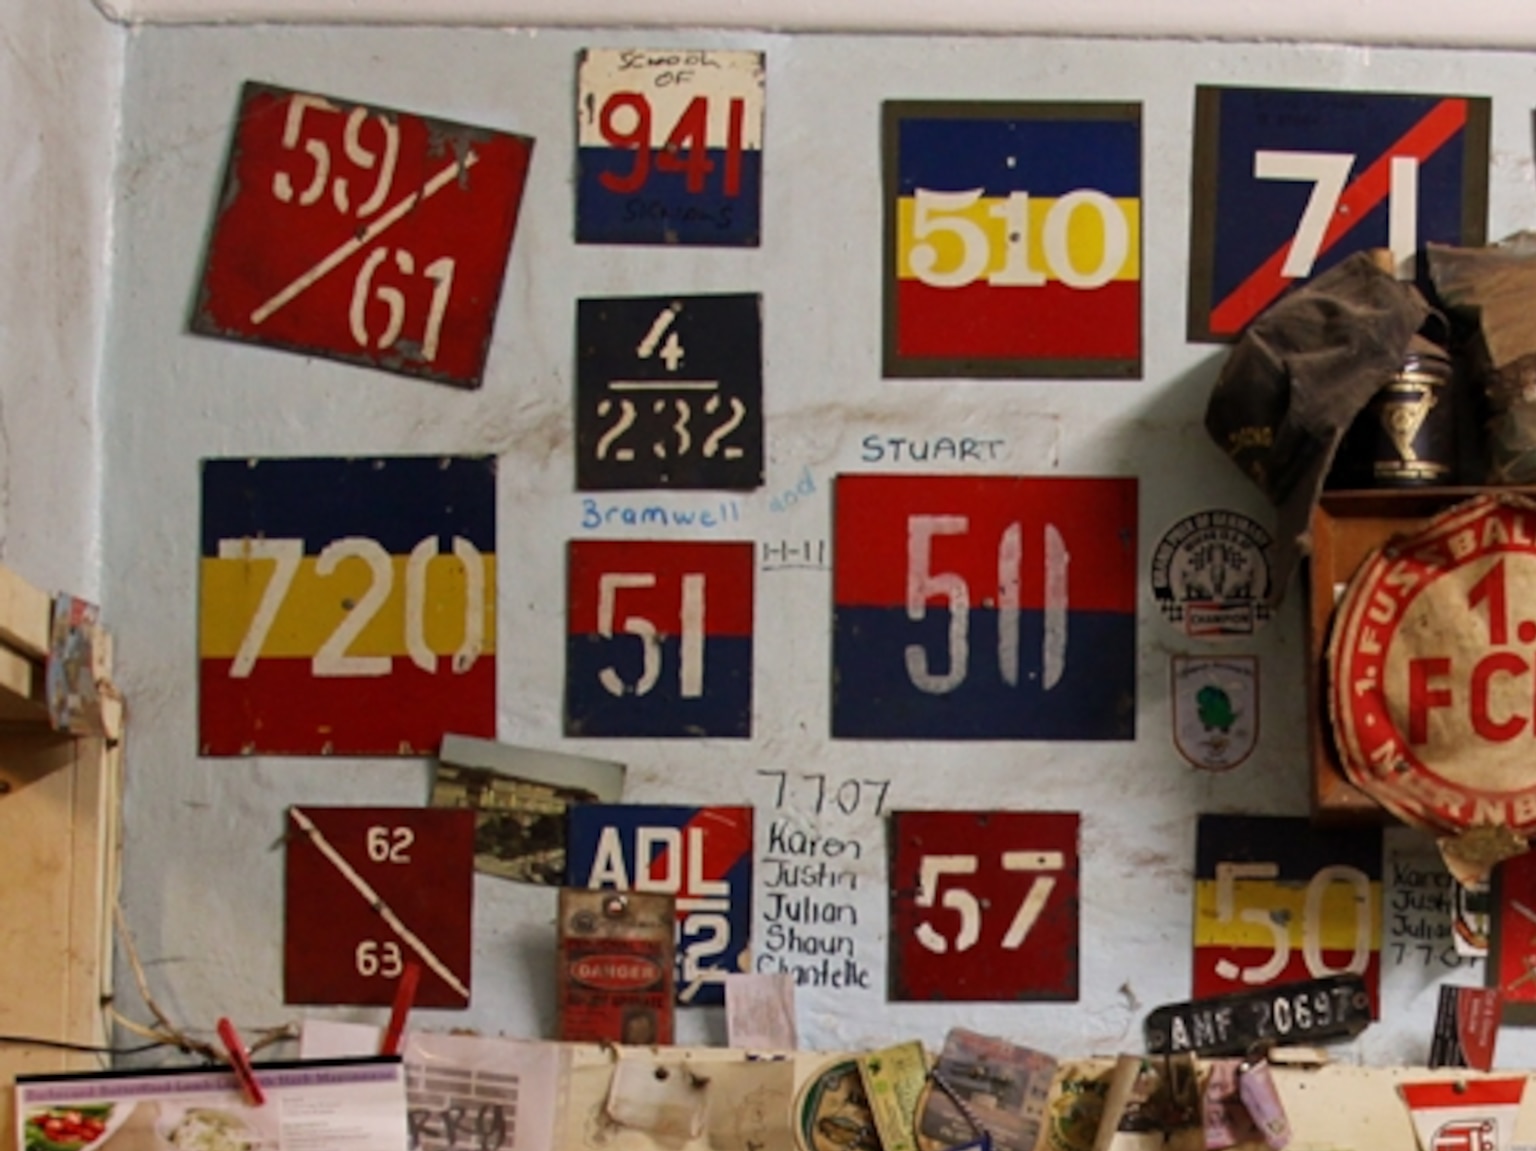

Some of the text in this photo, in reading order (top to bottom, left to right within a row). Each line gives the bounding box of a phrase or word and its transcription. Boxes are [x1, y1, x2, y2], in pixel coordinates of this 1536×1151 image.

[654, 71, 694, 87] OF
[273, 93, 400, 219] 59
[598, 90, 745, 199] 941
[908, 187, 1130, 290] 510
[1253, 149, 1419, 281] 71
[350, 245, 456, 363] 61
[638, 307, 684, 370] 4
[596, 397, 745, 460] 232
[861, 436, 1005, 463] STUART
[581, 499, 740, 529] Bramwell
[218, 535, 486, 679] 720
[598, 572, 706, 698] 51
[366, 827, 415, 865] 62
[588, 825, 731, 896] ADL
[768, 821, 861, 860] Karen
[761, 857, 858, 891] Justin
[915, 850, 1065, 954] 57
[762, 893, 858, 926] Julian
[765, 922, 854, 959] Shaun
[1214, 861, 1371, 984] 50
[354, 940, 404, 978] 63
